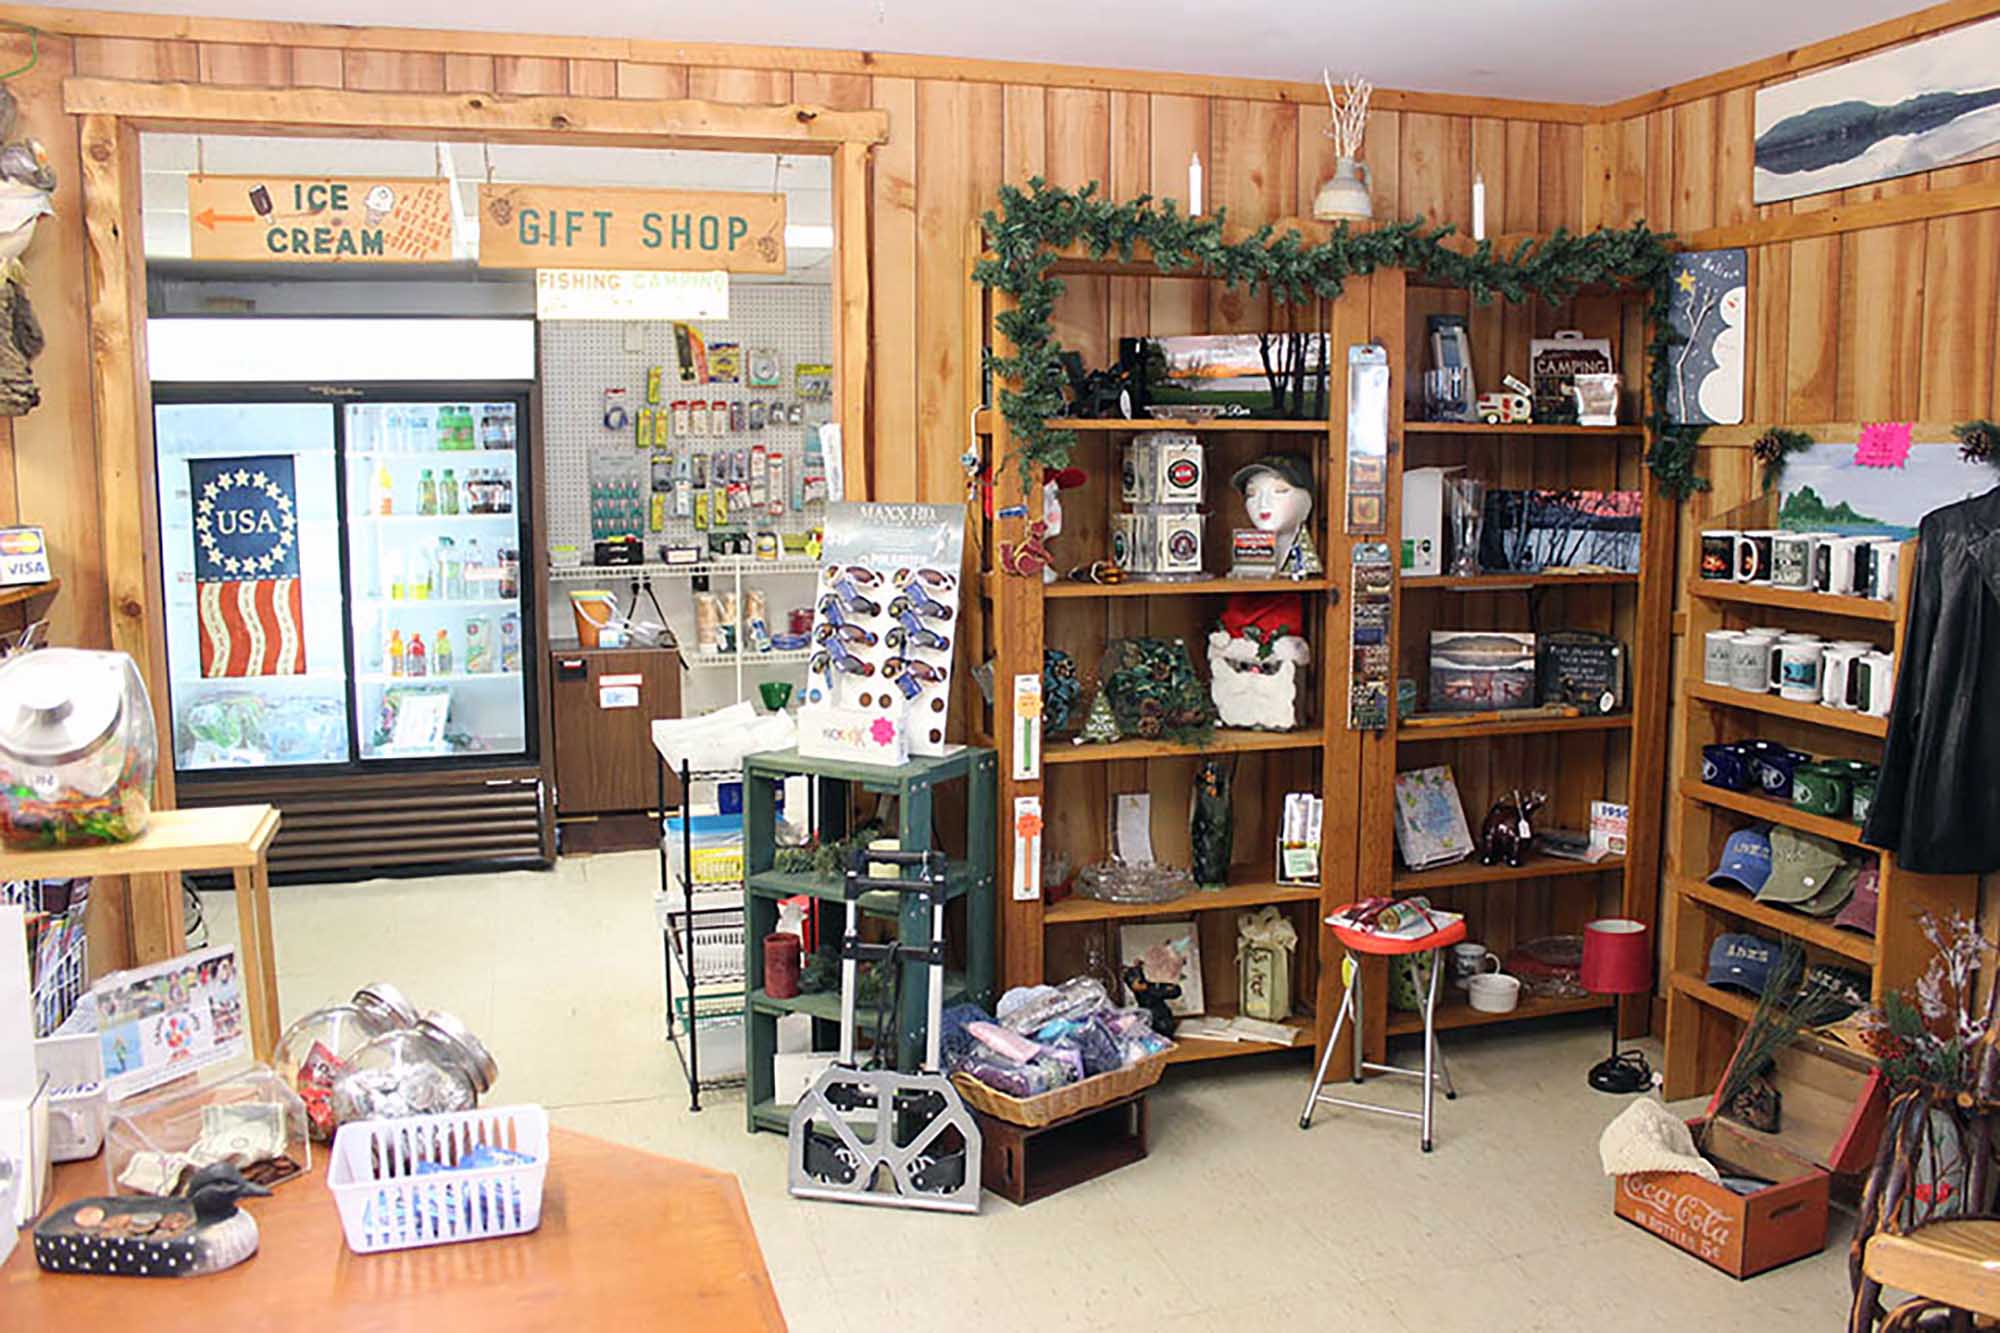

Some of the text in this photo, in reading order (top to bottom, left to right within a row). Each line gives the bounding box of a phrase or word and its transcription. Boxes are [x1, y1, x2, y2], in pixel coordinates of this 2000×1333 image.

[294, 184, 348, 210] ICE
[267, 228, 384, 255] CREAM
[519, 209, 748, 251] GIFT SHOP
[538, 271, 622, 290] FISHING
[1537, 360, 1606, 375] CAMPING
[216, 509, 278, 534] USA
[8, 561, 45, 575] VISA
